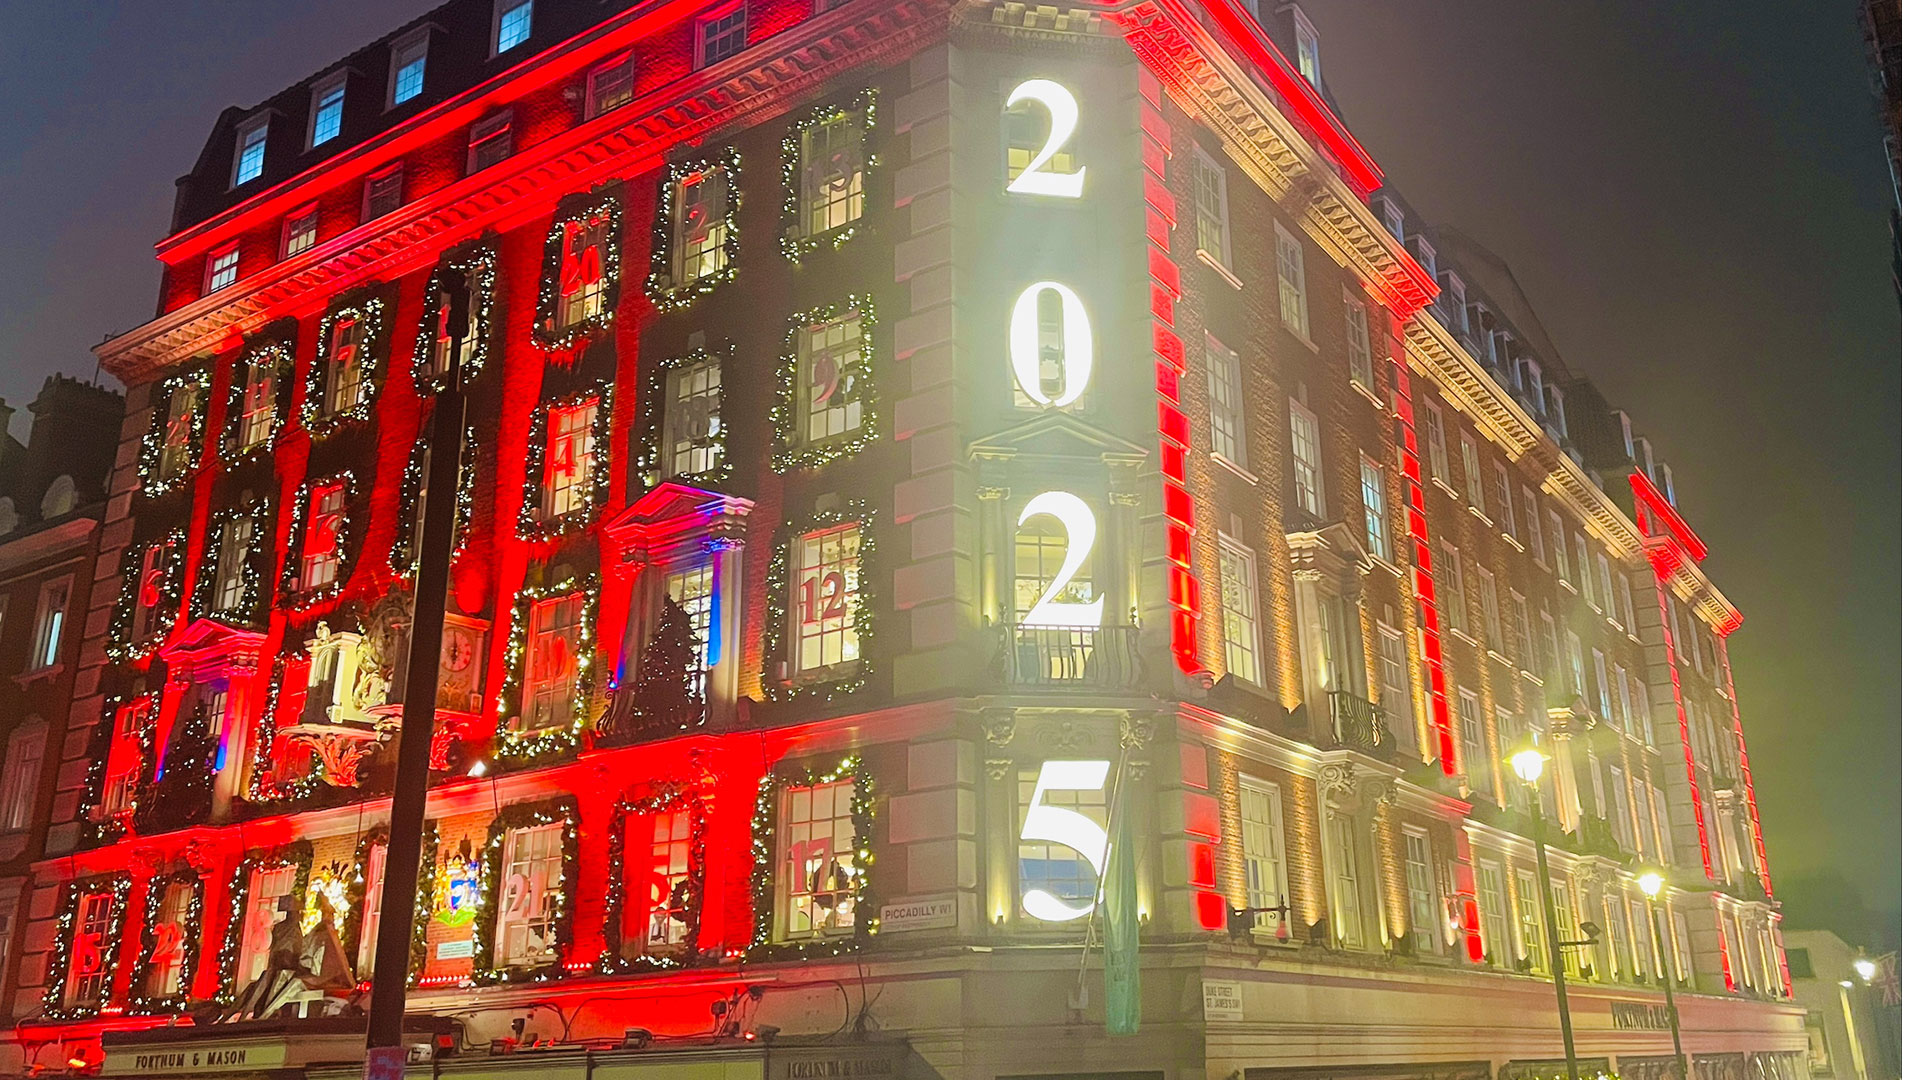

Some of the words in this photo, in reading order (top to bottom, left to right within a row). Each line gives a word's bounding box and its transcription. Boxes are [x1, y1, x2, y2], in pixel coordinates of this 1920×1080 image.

[688, 203, 708, 245] 2
[562, 245, 601, 297] 20
[336, 345, 357, 374] 7
[813, 349, 839, 404] 9
[553, 434, 578, 478] 4
[142, 568, 163, 608] 6
[800, 571, 848, 625] 12
[788, 836, 833, 895] 17
[505, 869, 549, 922] 21
[885, 905, 937, 920] PICCADILLY
[940, 904, 952, 915] W1
[149, 921, 184, 964] 22
[135, 1053, 185, 1069] FORTNUM
[207, 1050, 246, 1065] MASON
